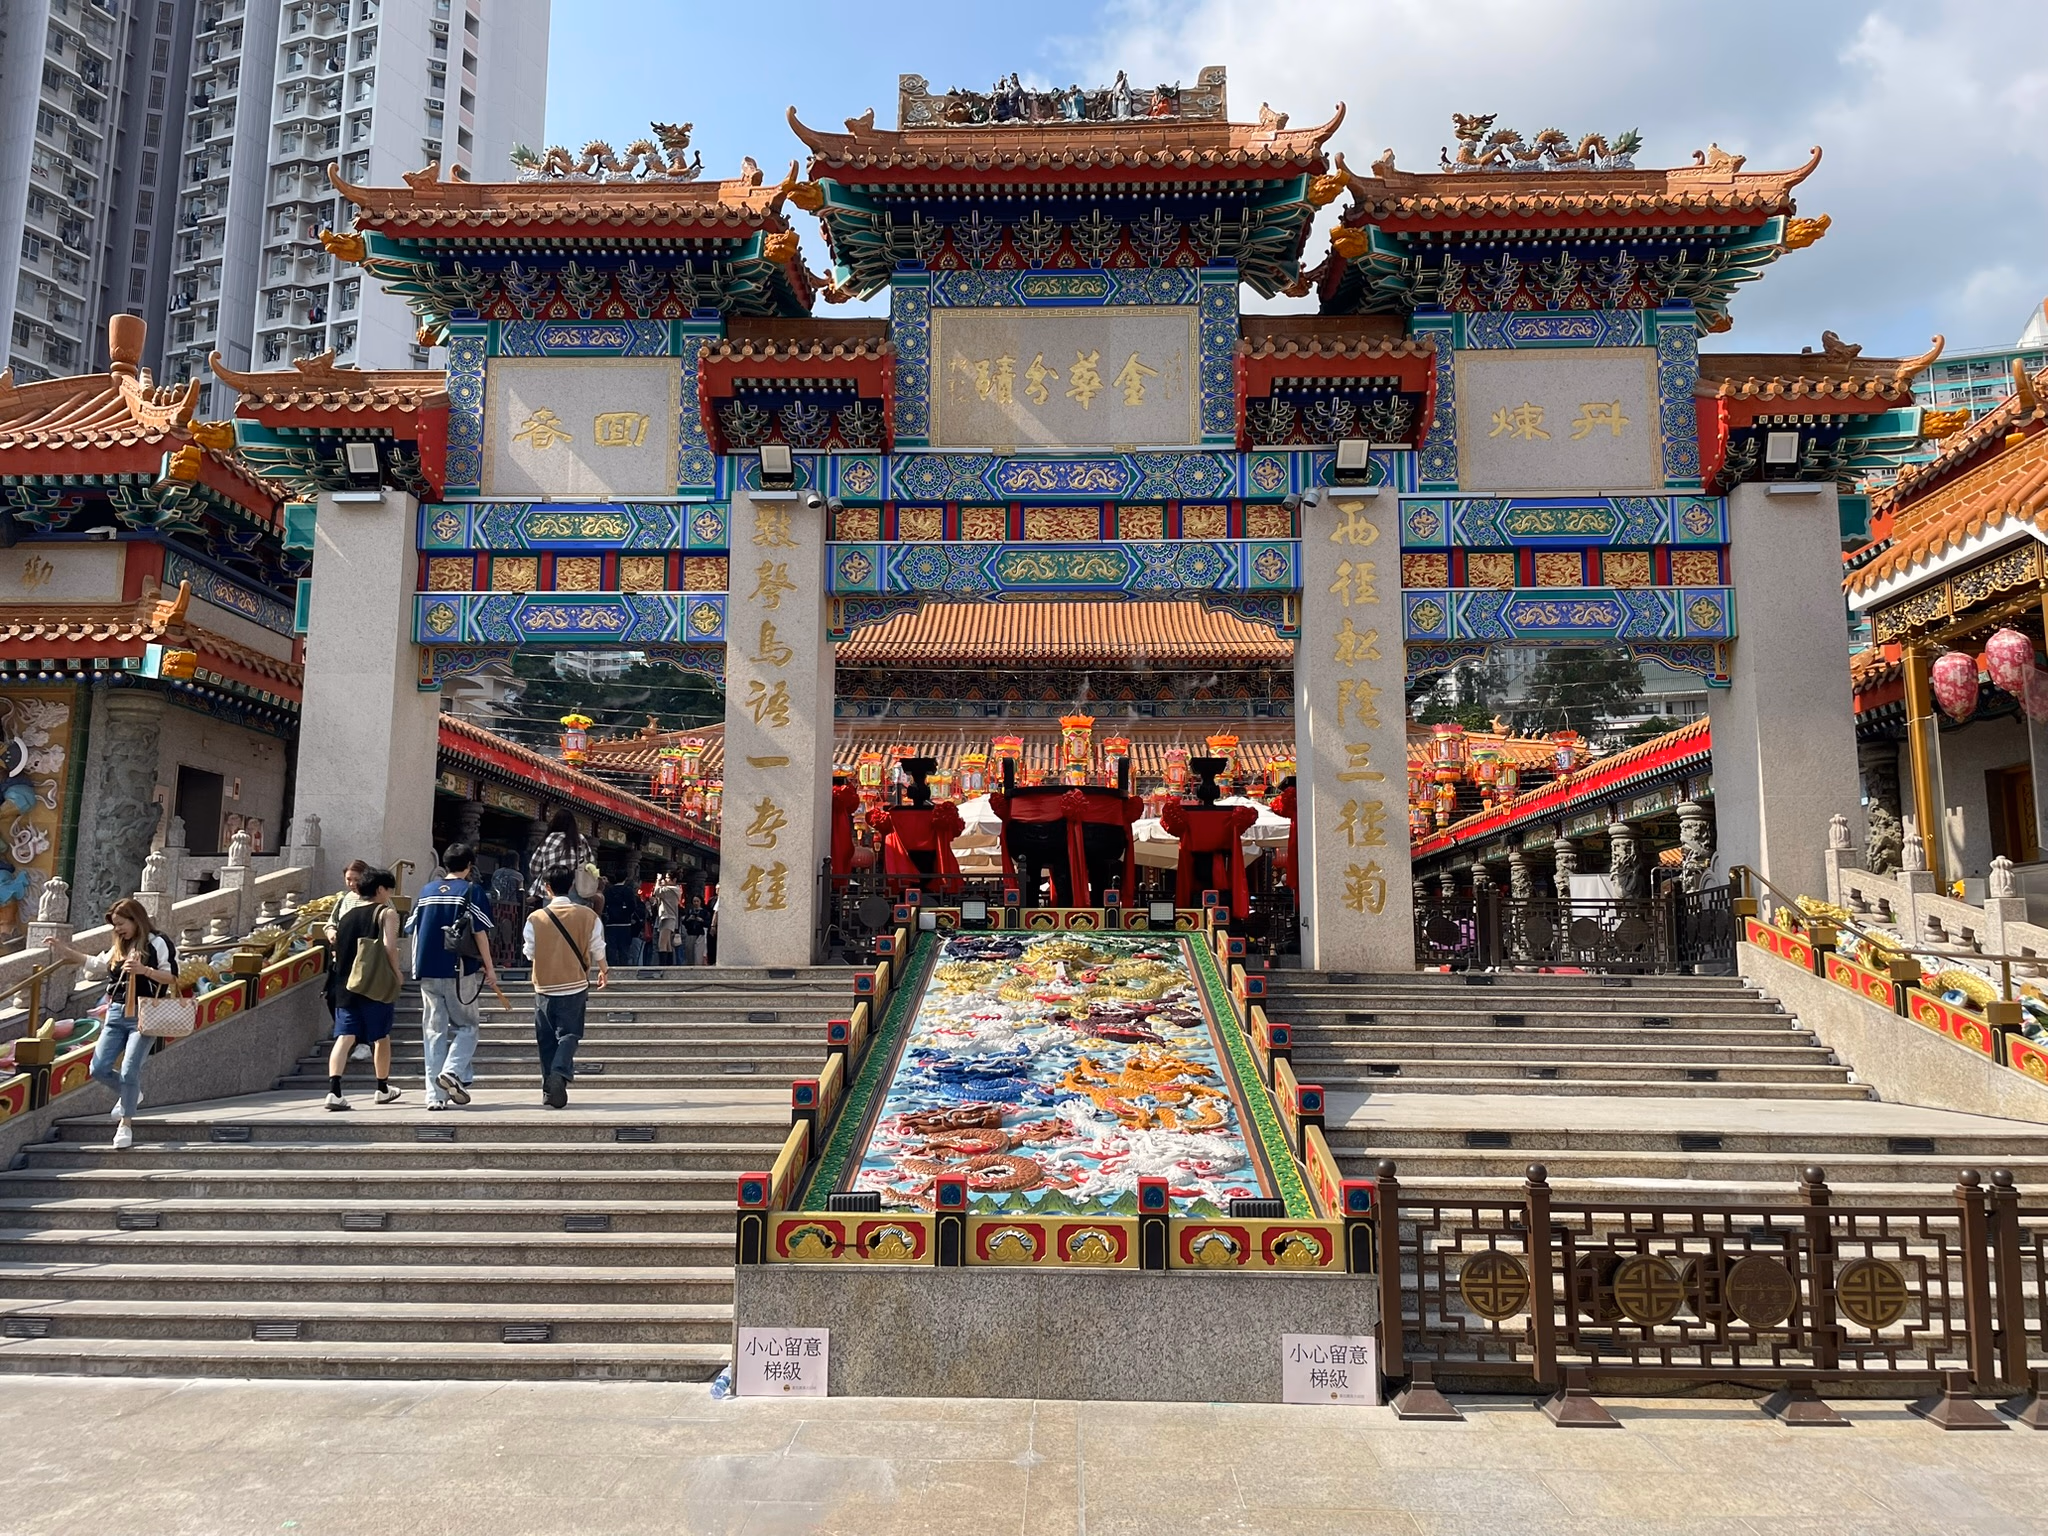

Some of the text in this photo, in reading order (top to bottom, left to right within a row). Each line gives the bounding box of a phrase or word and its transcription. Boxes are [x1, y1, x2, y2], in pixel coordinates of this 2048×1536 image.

[744, 1336, 822, 1357] 小心留意
[1289, 1343, 1368, 1365] 小心留意
[763, 1360, 802, 1381] 梯級
[1309, 1368, 1349, 1389] 梯級
